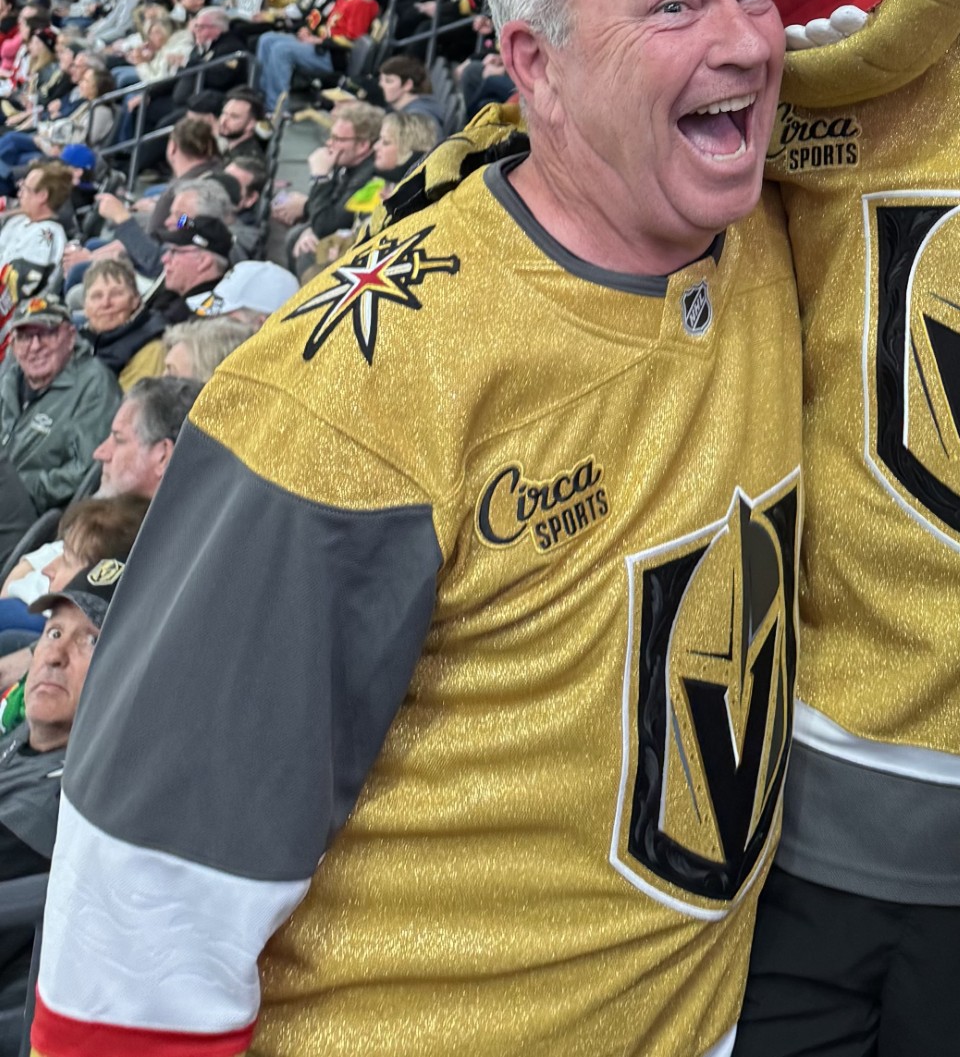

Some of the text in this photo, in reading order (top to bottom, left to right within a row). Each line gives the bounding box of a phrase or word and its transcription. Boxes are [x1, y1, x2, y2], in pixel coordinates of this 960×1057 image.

[789, 143, 857, 170] SPORTS
[478, 459, 602, 545] Circa
[534, 489, 610, 550] SPORTS
